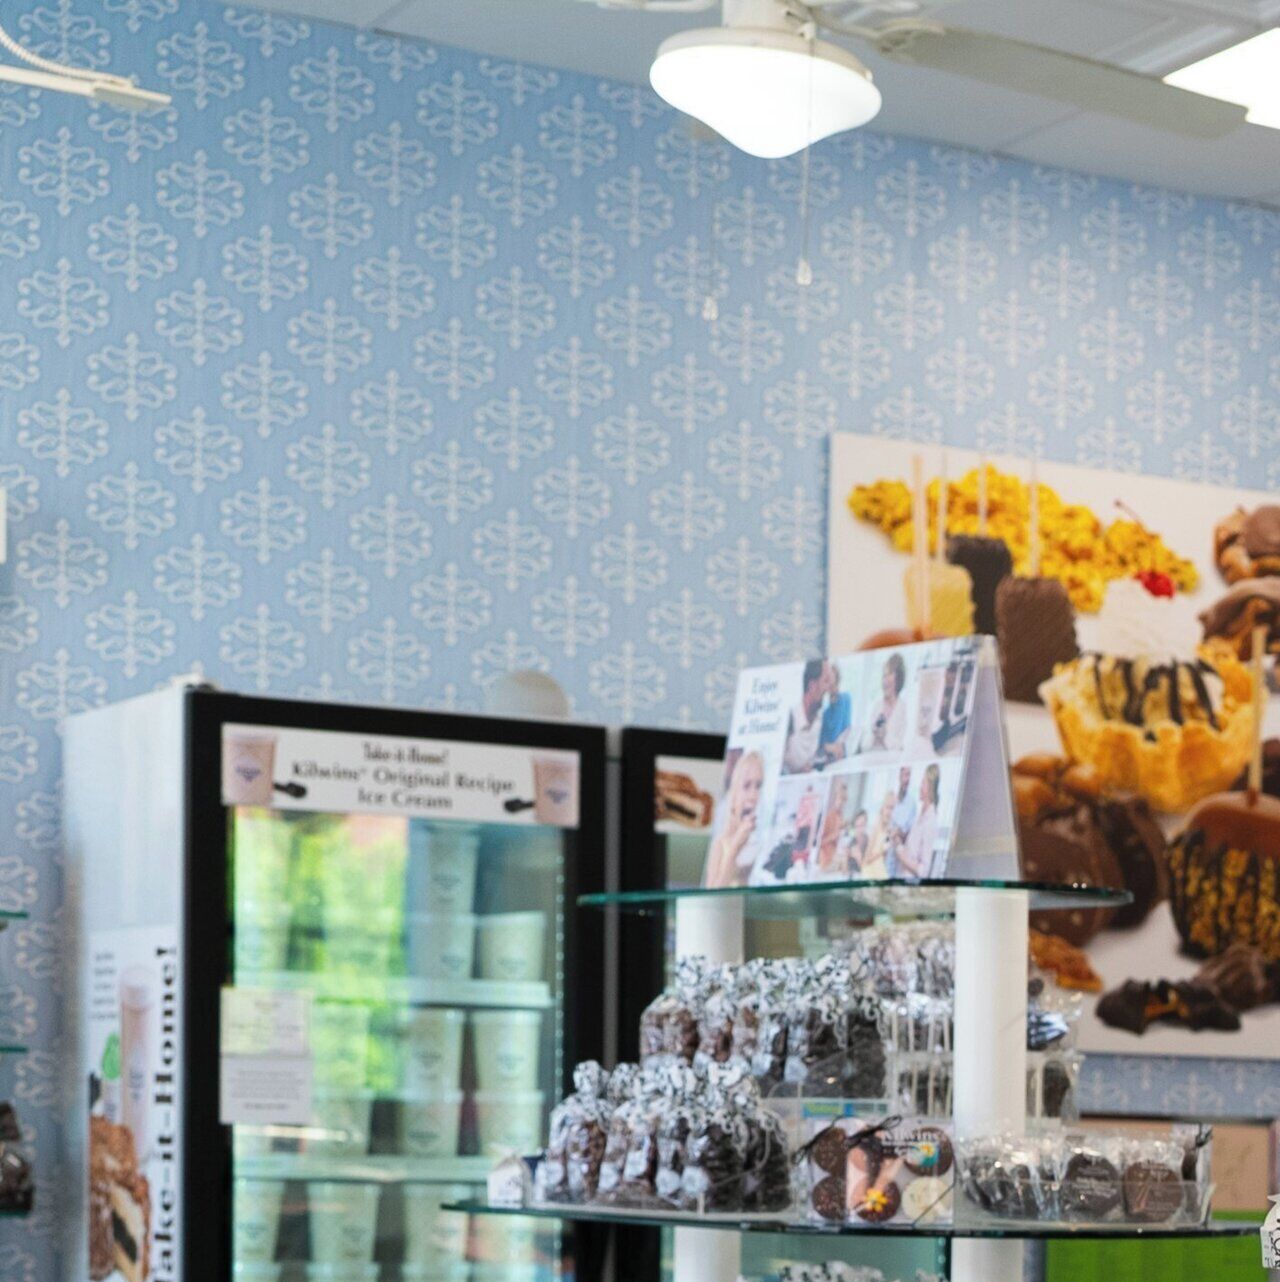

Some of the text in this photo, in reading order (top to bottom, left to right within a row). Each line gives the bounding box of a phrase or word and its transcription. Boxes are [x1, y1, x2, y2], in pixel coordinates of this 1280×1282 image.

[372, 768, 450, 789] Original
[455, 772, 514, 795] Recipe
[358, 790, 453, 809] Ice Cream
